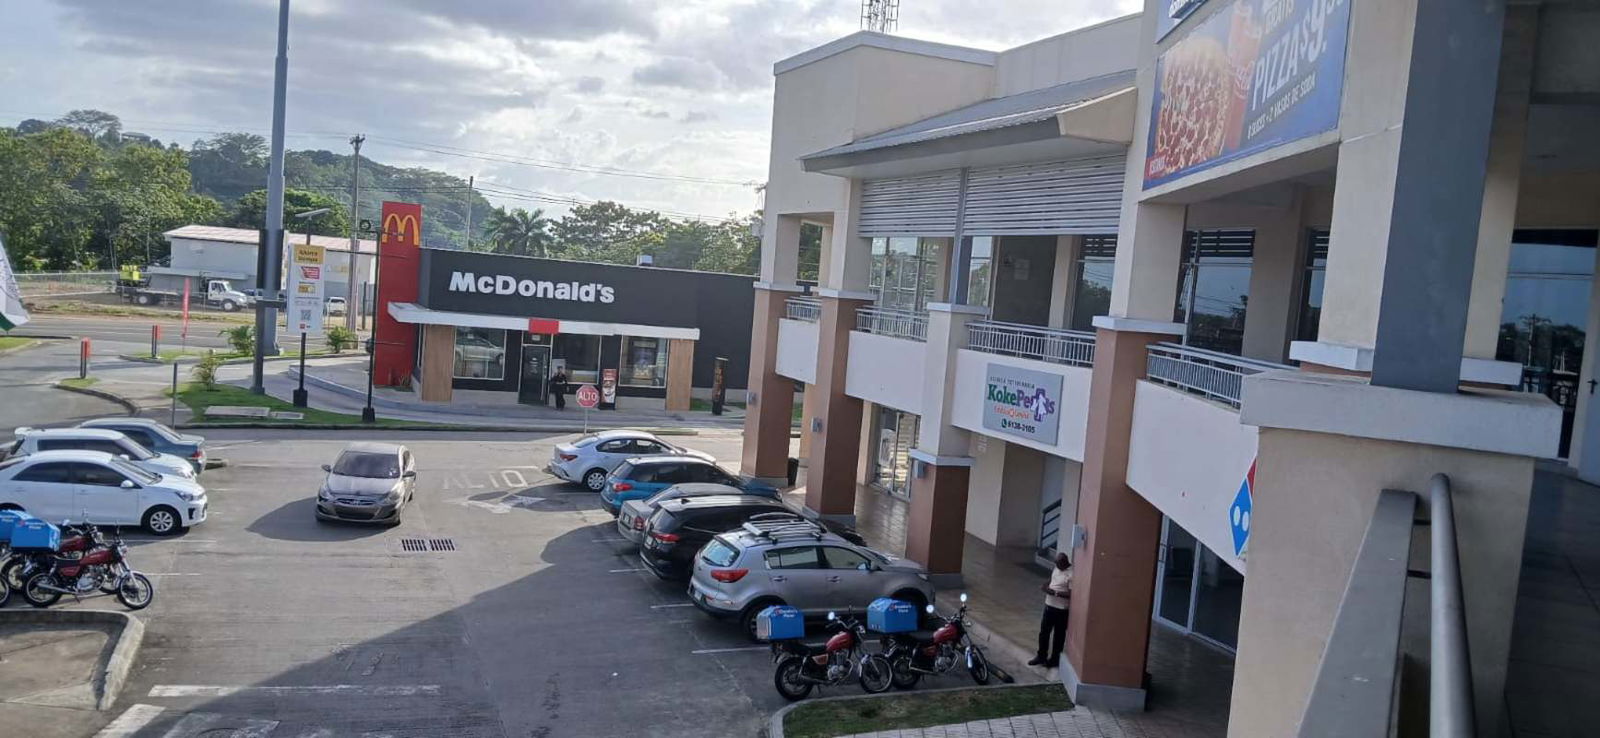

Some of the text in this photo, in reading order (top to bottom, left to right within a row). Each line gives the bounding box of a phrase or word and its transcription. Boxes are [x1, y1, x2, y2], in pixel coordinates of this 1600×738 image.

[1252, 22, 1300, 111] PIZZA
[448, 271, 615, 304] McDonald's
[579, 391, 597, 402] ALTO
